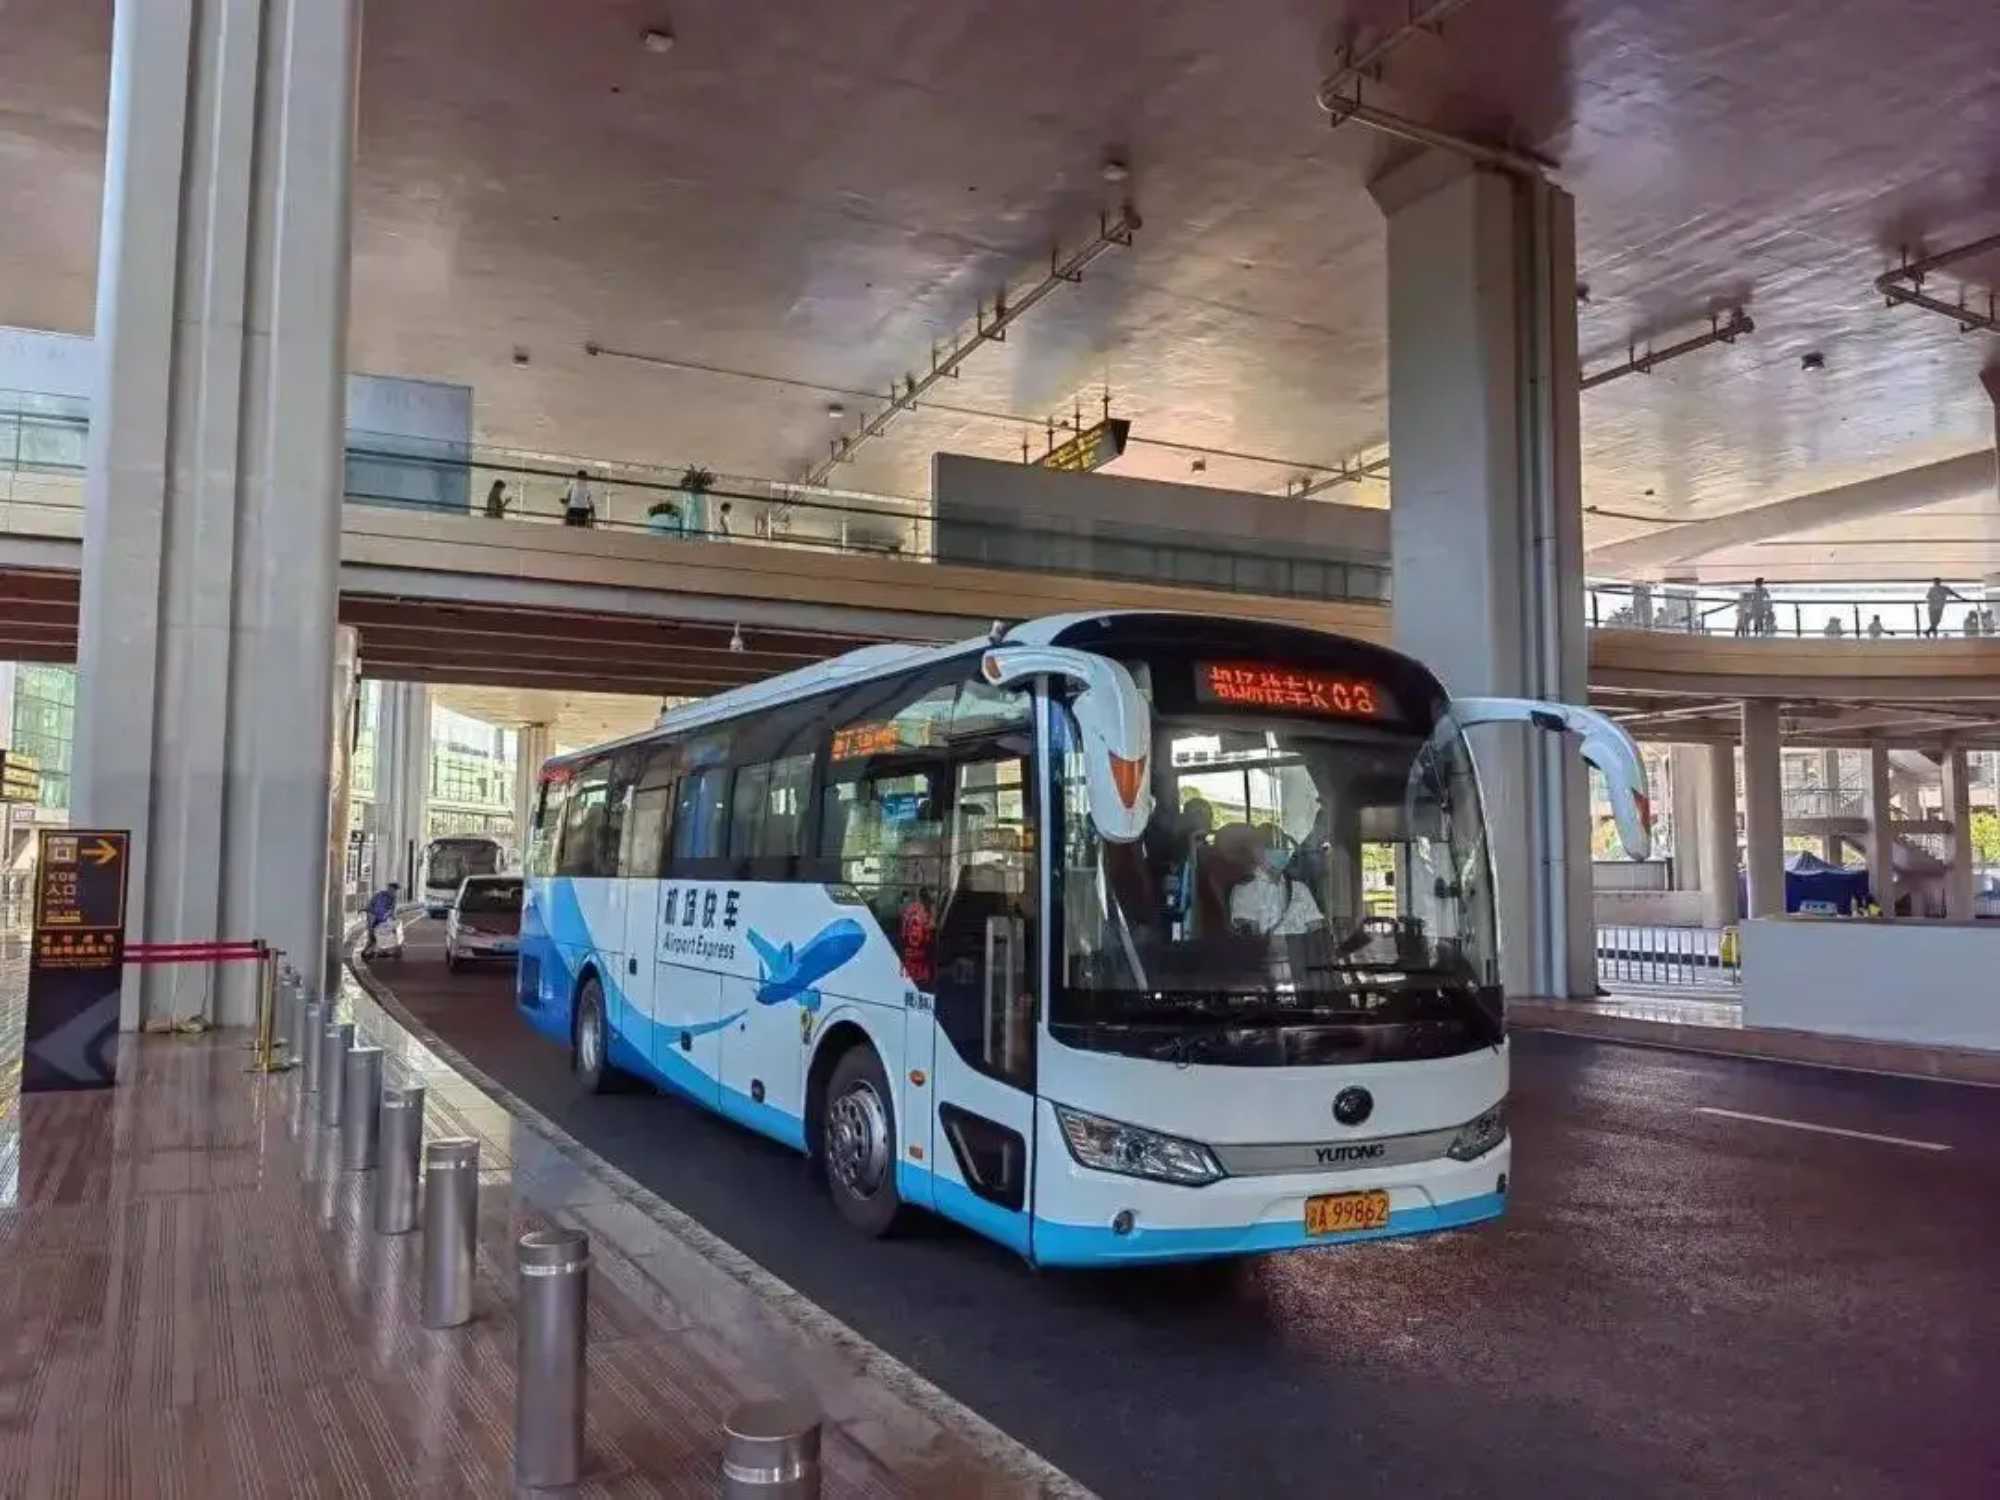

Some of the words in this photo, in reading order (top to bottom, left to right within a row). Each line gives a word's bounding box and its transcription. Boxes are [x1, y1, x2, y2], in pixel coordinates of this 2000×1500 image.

[46, 883, 77, 896] 入口
[664, 888, 740, 931] 机场快车
[662, 932, 696, 955] Airport
[696, 934, 735, 960] Express
[1315, 1144, 1385, 1163] YUTONG
